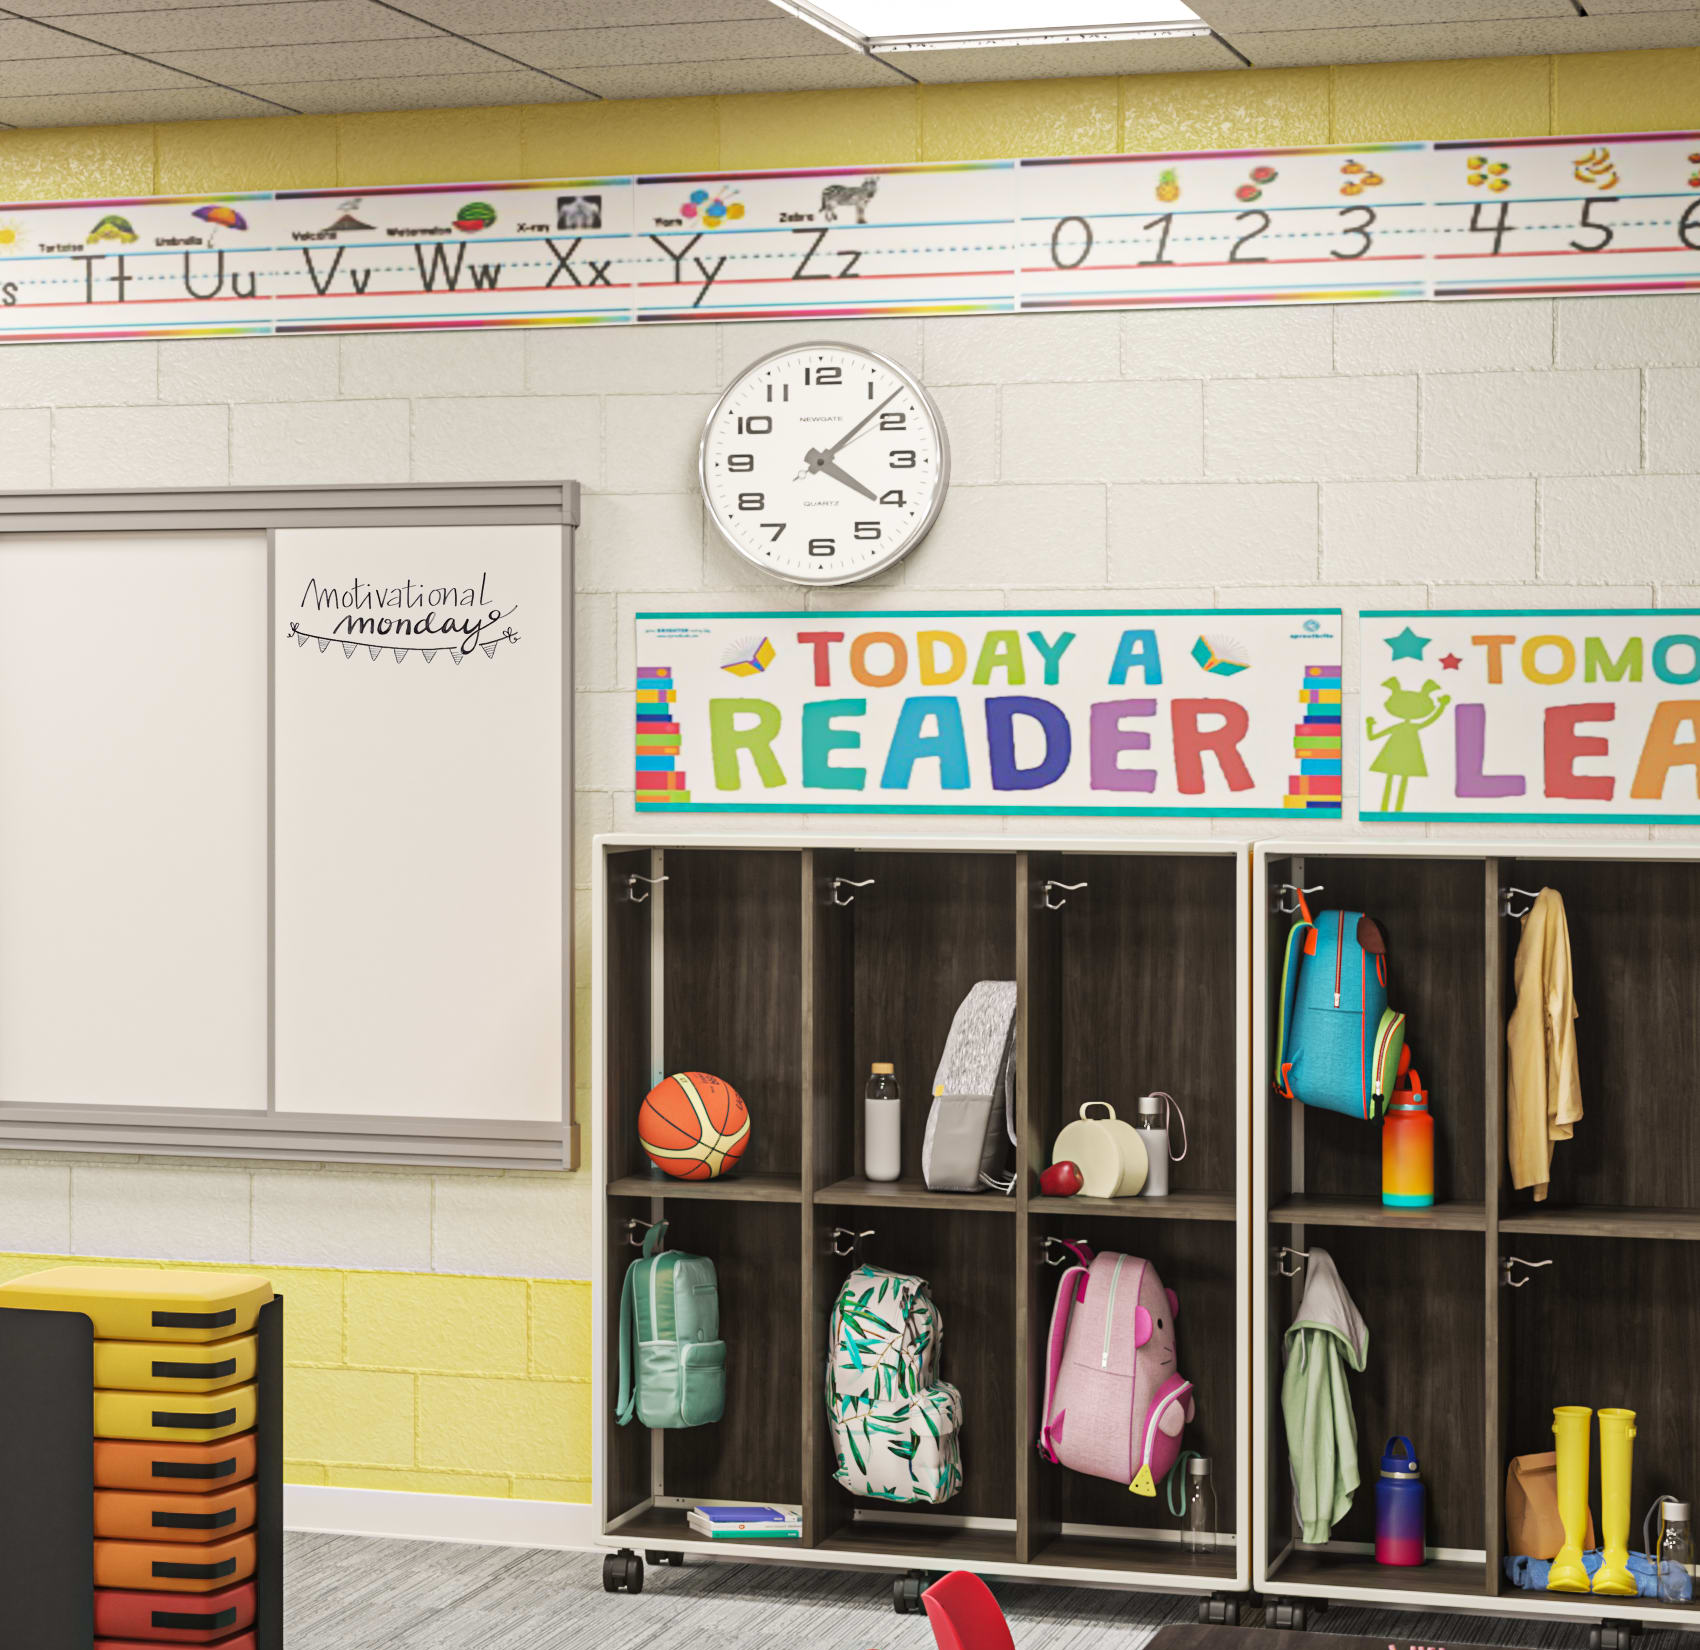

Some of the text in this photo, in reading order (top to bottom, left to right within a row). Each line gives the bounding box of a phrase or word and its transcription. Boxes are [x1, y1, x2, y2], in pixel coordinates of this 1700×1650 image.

[1470, 201, 1514, 253] 4
[1571, 197, 1620, 251] 5
[1053, 206, 1375, 268] 0 1 2 3
[806, 367, 842, 385] 12
[768, 385, 787, 401] 11
[869, 382, 873, 399] 1
[738, 417, 771, 434] 10
[880, 413, 906, 430] 2
[728, 455, 753, 472] 9
[890, 451, 915, 468] 3
[739, 493, 764, 510] 8
[880, 490, 906, 507] 4
[761, 524, 786, 541] 7
[855, 522, 880, 539] 5
[809, 539, 834, 556] 6
[300, 572, 493, 611] Motivational
[332, 605, 518, 655] monday
[797, 629, 1163, 688] TODAY A
[709, 695, 1256, 794] READER
